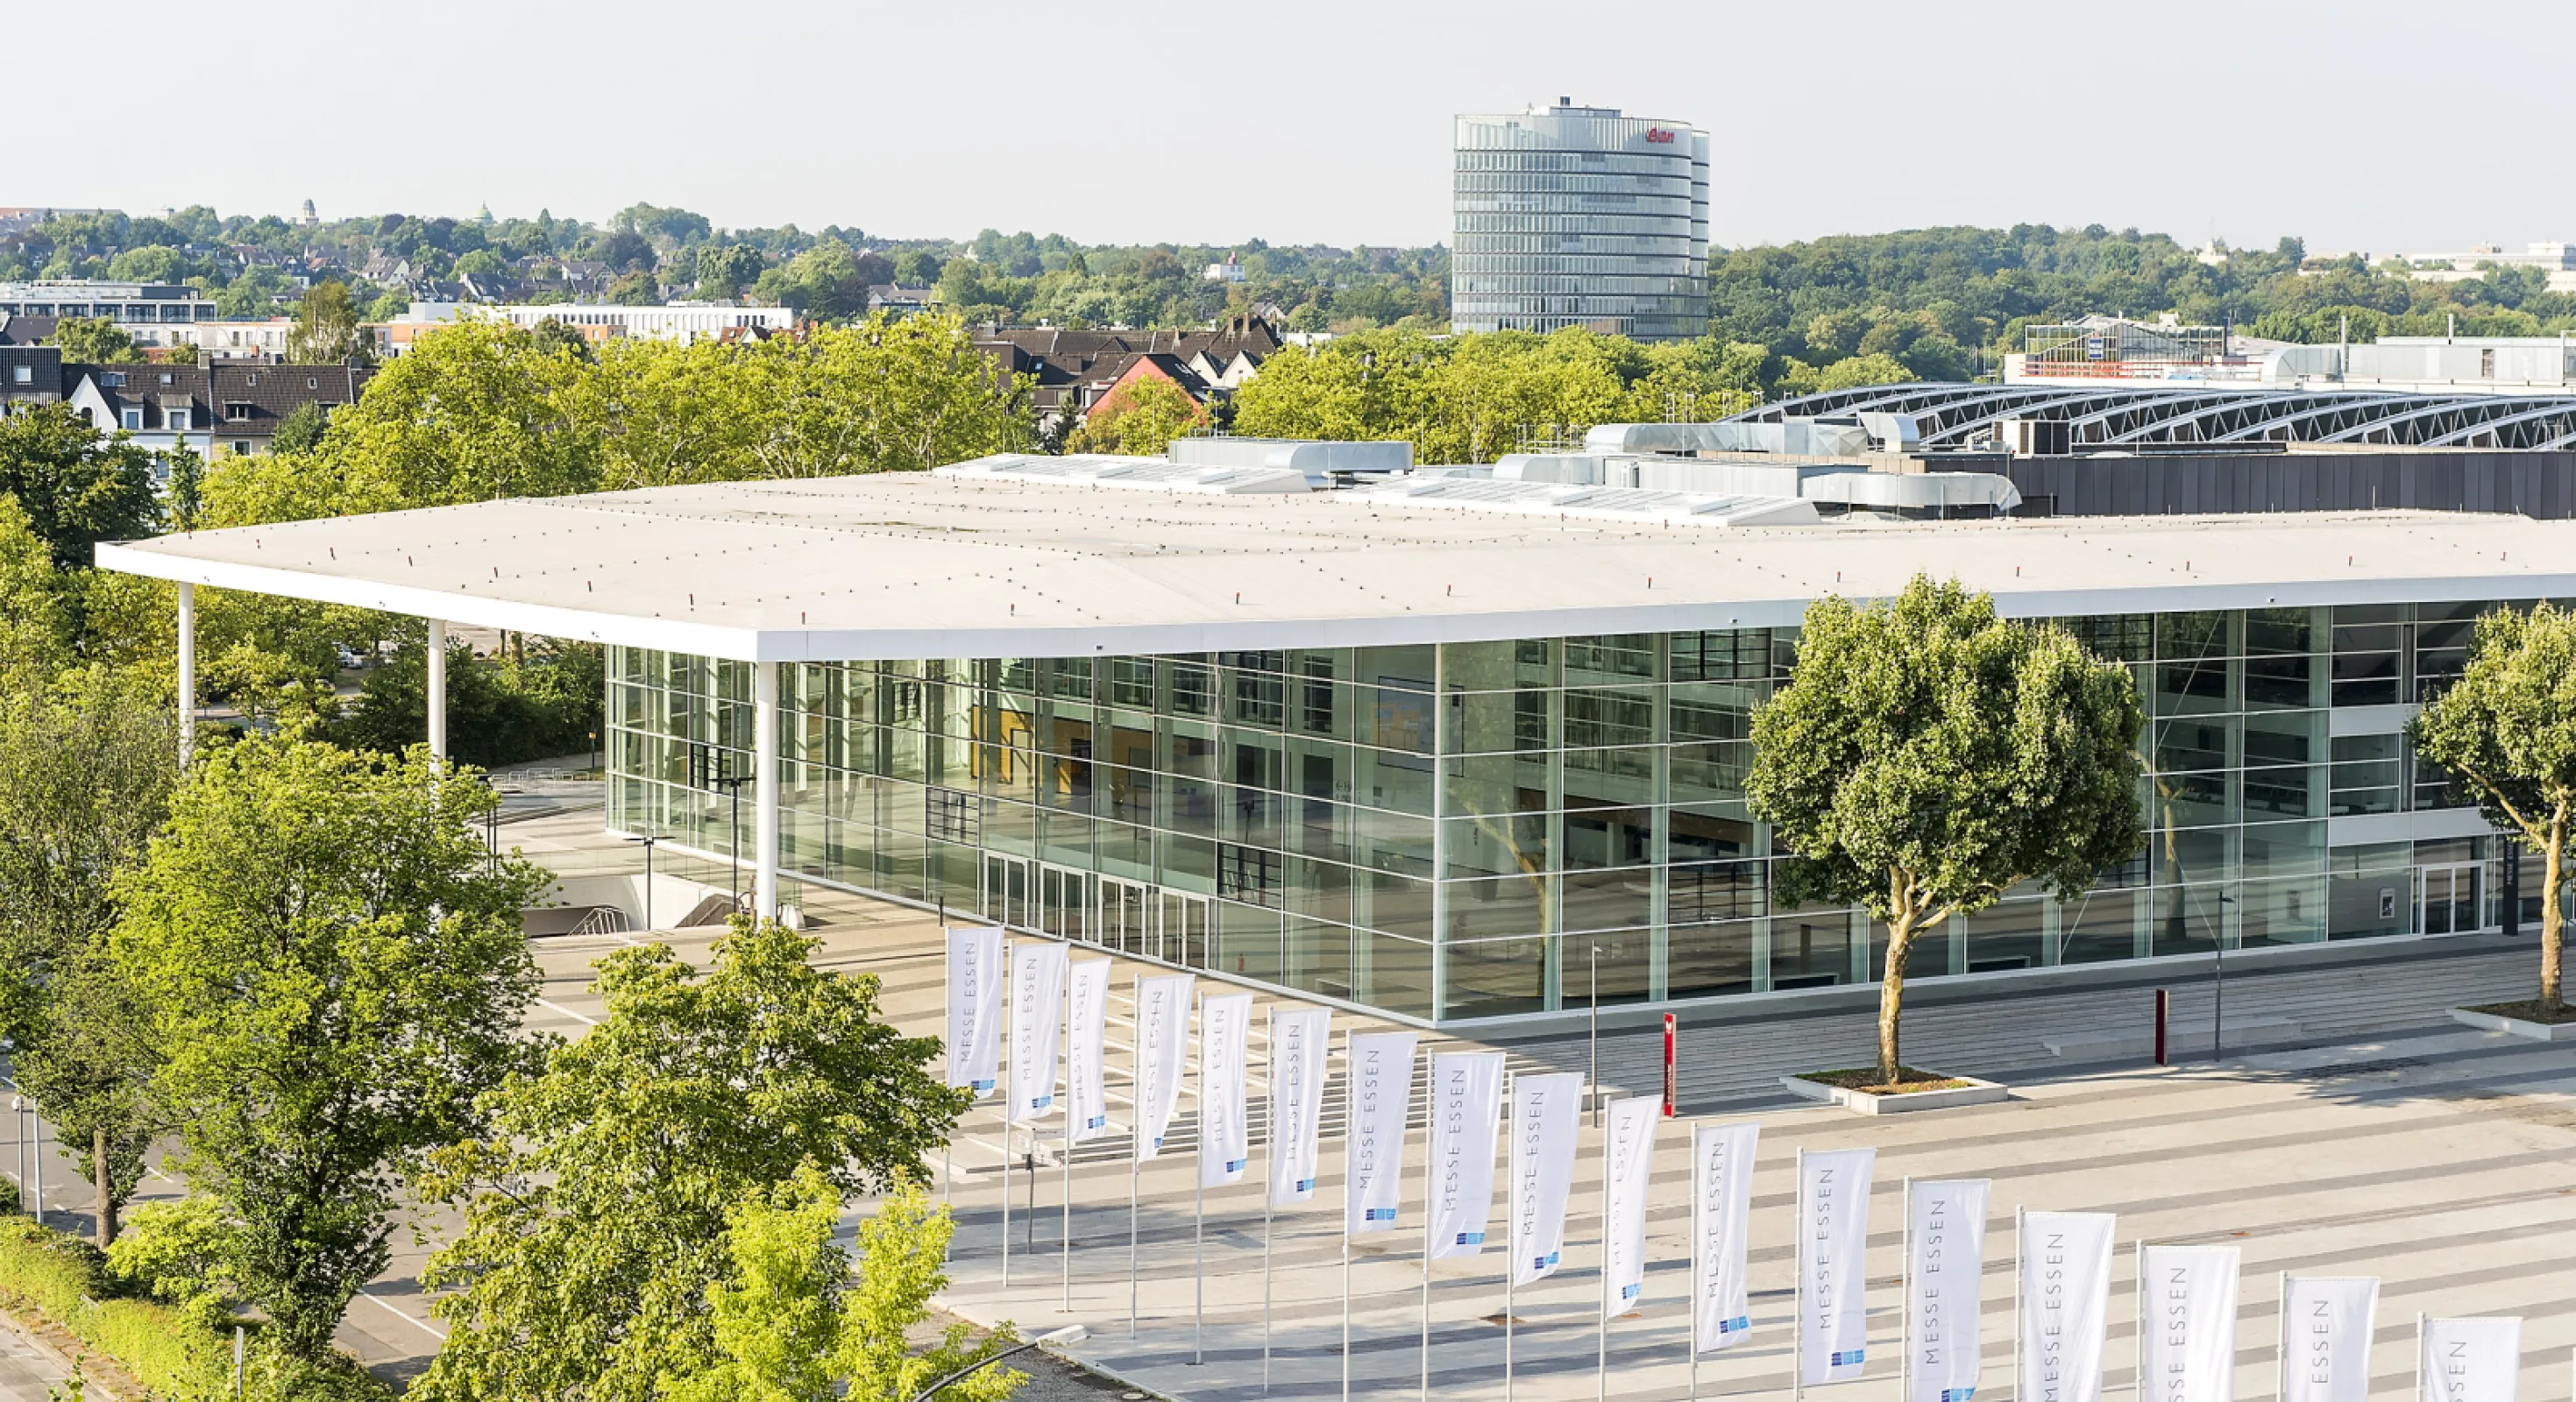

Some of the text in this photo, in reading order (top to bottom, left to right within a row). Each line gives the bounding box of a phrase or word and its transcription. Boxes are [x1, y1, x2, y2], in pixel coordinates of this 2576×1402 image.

[961, 942, 976, 1062] MESSE ESSEN
[1023, 958, 1038, 1080] MESSE ESSEN
[1148, 991, 1164, 1049] ESSEN
[1213, 1009, 1225, 1070] ESSEN
[1288, 1024, 1301, 1087] ESSEN
[1359, 1050, 1380, 1189] MESSE ESSEN
[1444, 1069, 1465, 1212] MESSE ESSEN
[1522, 1092, 1545, 1236] MESSE ESSEN
[1615, 1115, 1632, 1184] ESSEN
[1708, 1142, 1725, 1299] MESSE ESSEN
[1817, 1169, 1834, 1329] MESSE ESSEN
[1925, 1200, 1946, 1364] MESSE ESSEN
[2044, 1234, 2065, 1402] MESSE ESSEN
[2168, 1268, 2188, 1402] SSE ESSEN
[2310, 1300, 2331, 1384] ESSEN
[2448, 1342, 2468, 1402] SEN
